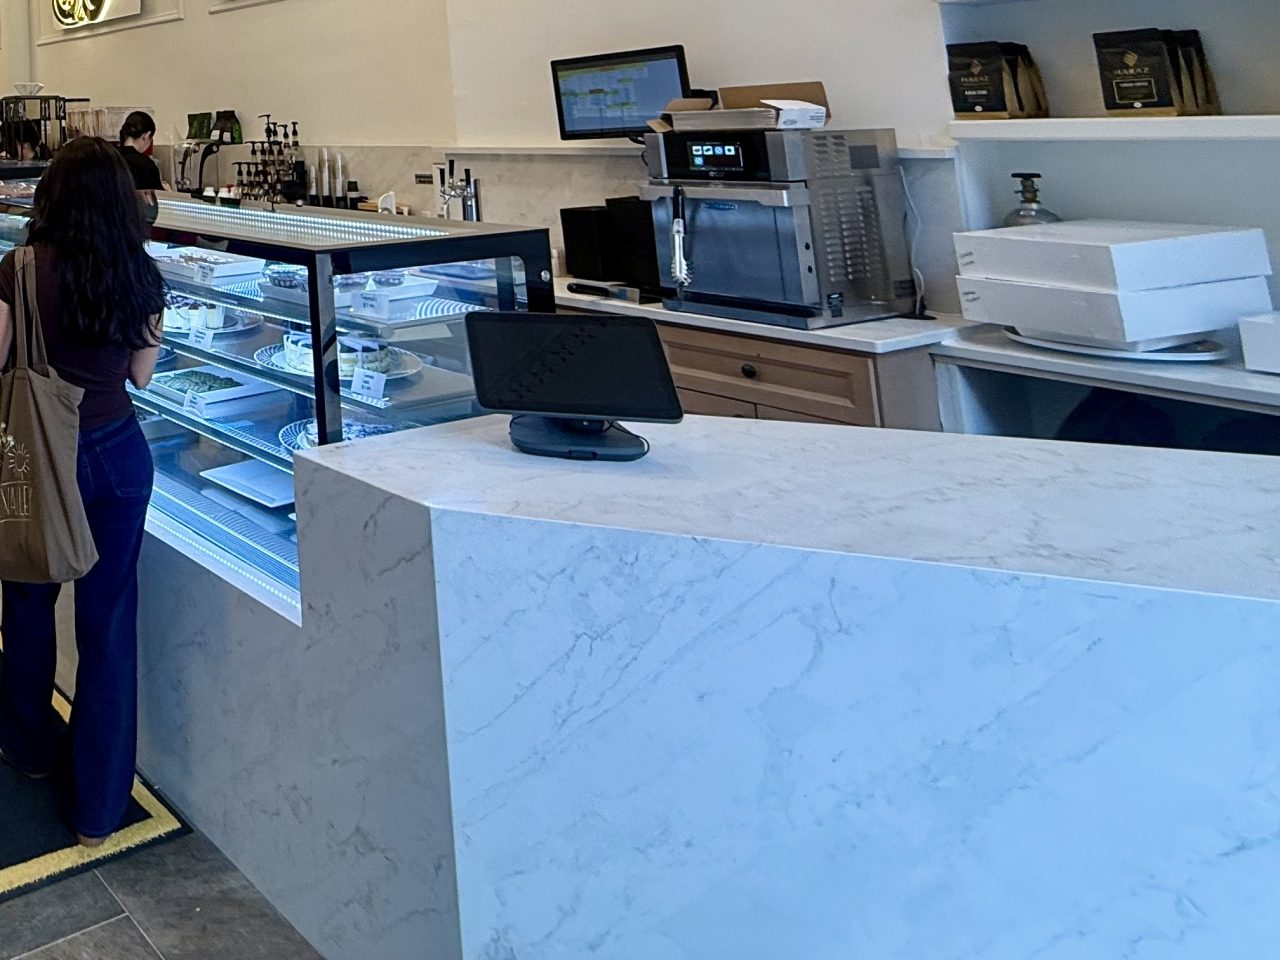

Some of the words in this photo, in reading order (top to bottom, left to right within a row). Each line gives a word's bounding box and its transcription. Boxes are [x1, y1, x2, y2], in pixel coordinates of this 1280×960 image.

[9, 103, 15, 117] 7
[41, 101, 49, 117] 11
[56, 101, 65, 117] 12
